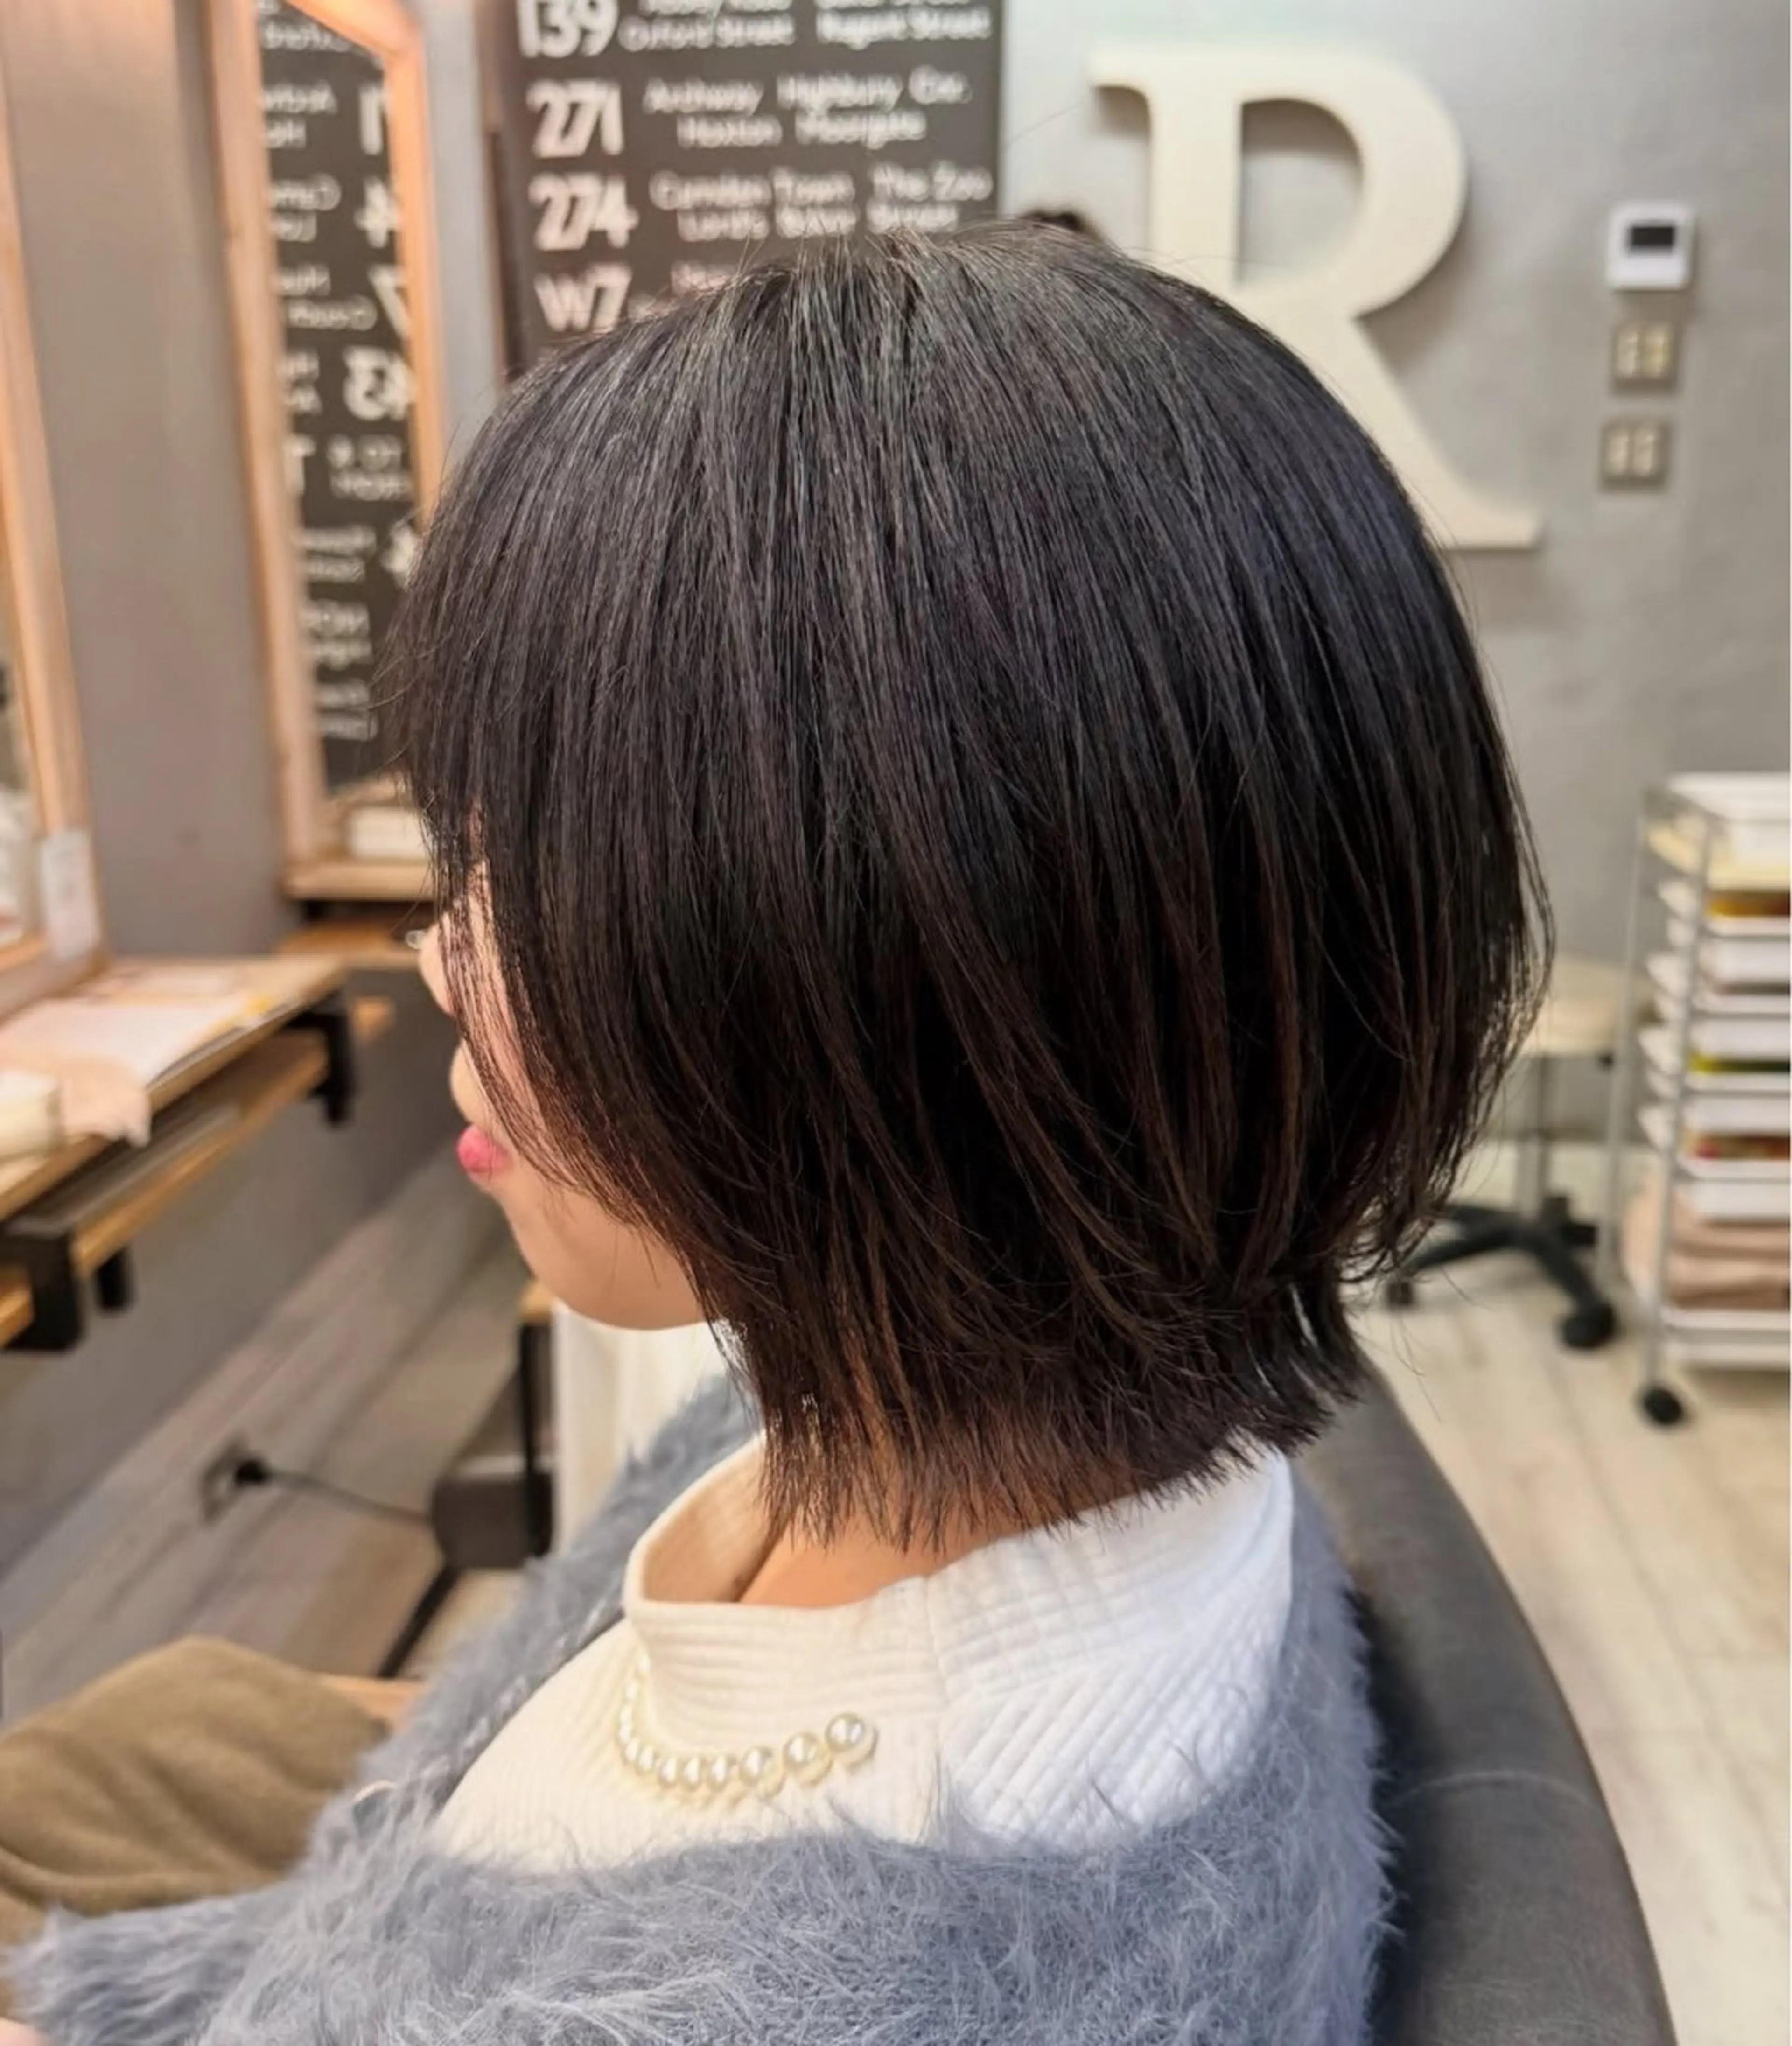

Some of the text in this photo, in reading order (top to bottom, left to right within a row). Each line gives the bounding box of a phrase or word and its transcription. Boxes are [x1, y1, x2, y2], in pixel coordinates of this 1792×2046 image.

[517, 0, 618, 57] 139
[526, 80, 624, 159] 271
[529, 173, 639, 251] 274
[533, 262, 632, 335] W7
[1087, 44, 1544, 548] R
